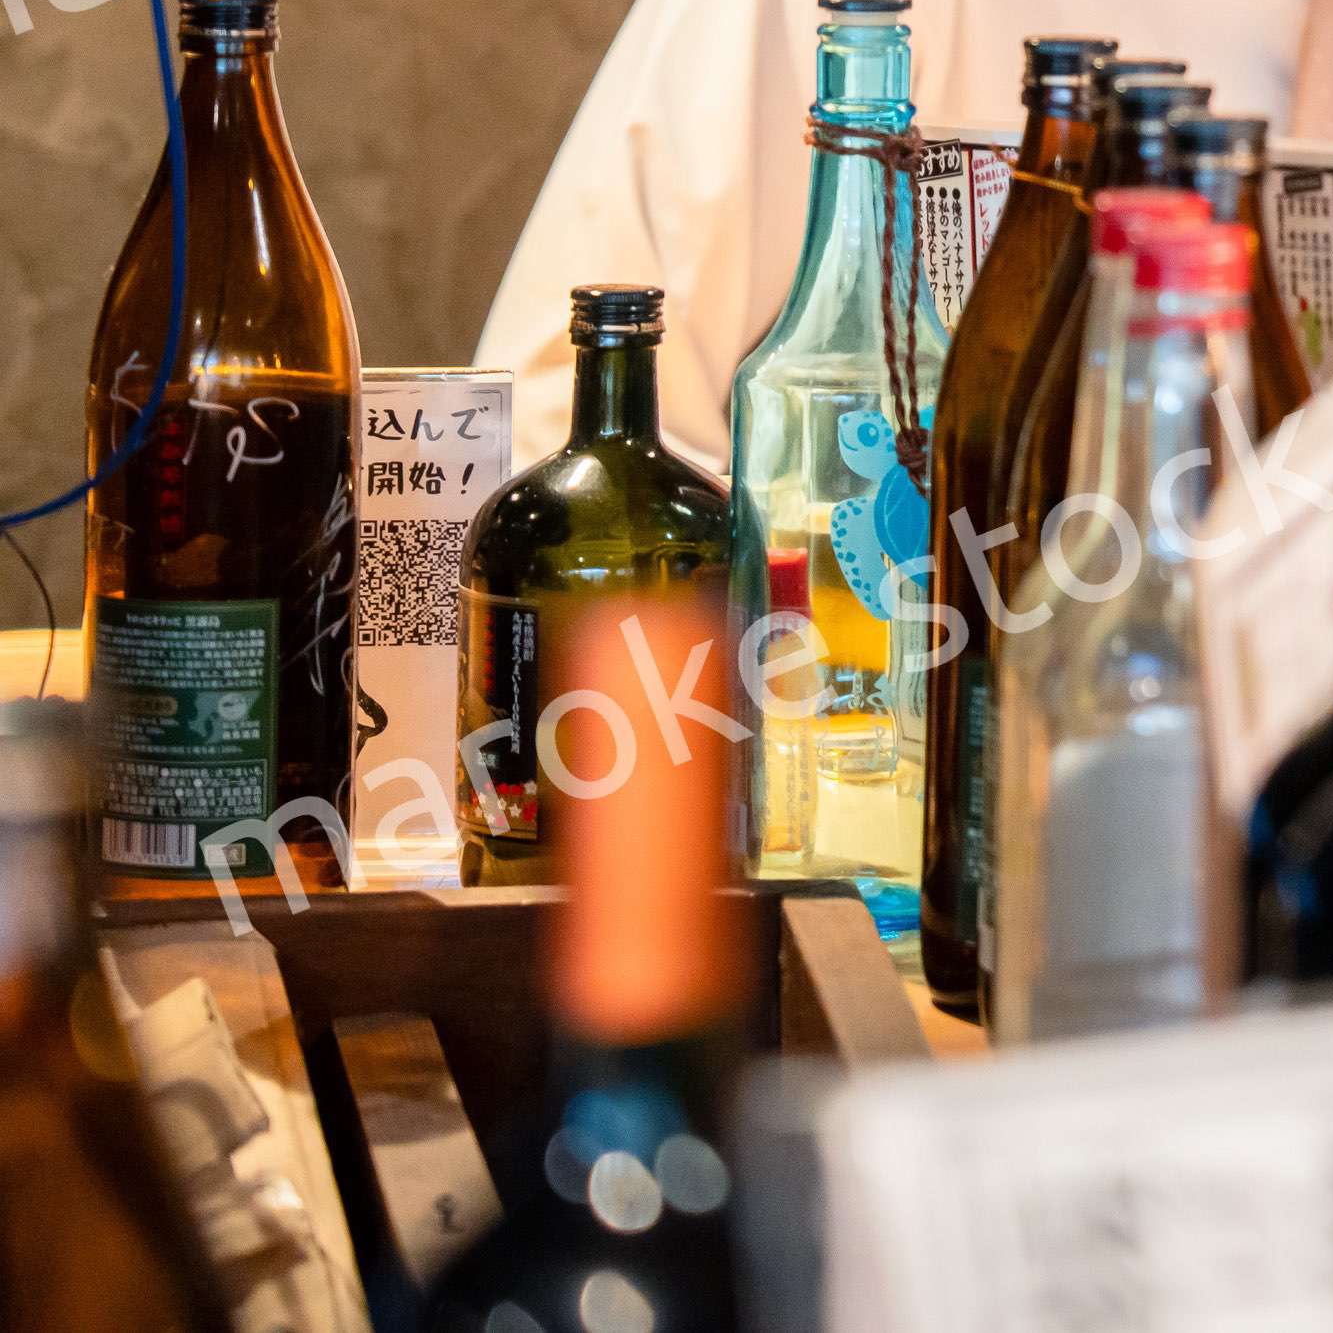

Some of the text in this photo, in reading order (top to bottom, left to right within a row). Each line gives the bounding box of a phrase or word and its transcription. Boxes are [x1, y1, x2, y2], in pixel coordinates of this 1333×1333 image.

[939, 200, 952, 323] 私のマンゴーサワー
[952, 202, 964, 312] 俺のバナナサワー
[367, 406, 489, 442] 込んで
